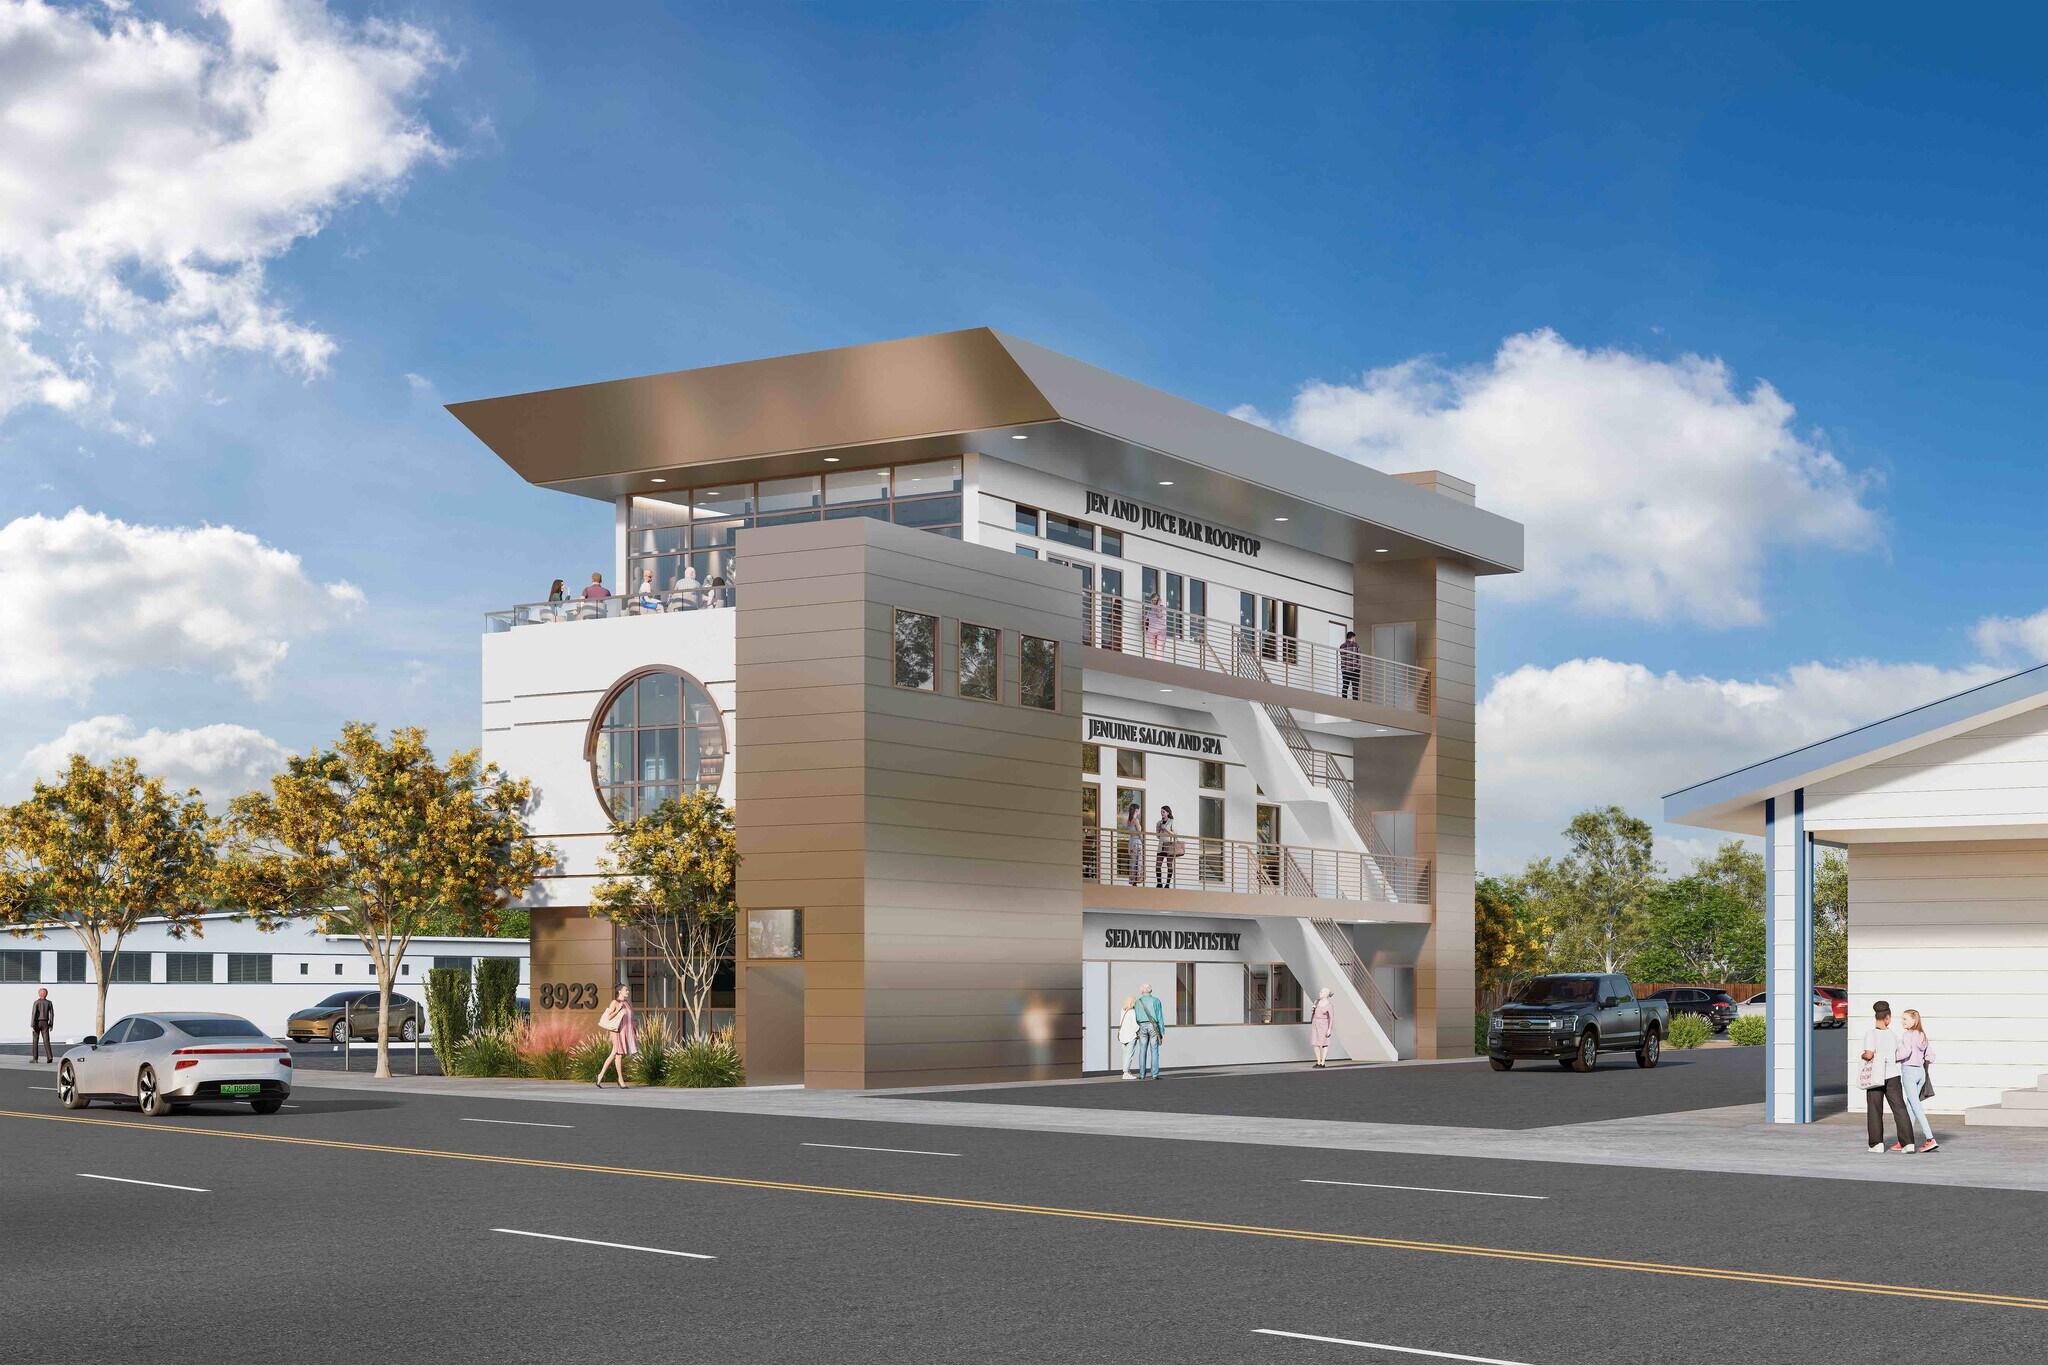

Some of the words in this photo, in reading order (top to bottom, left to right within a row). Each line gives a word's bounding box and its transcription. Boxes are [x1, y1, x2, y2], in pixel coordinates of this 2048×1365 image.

[1085, 490, 1109, 515] JEN
[1110, 499, 1140, 523] AND
[1141, 507, 1176, 534] JUICE
[1178, 518, 1203, 542] BAR
[1204, 525, 1261, 557] ROOFTOP
[1088, 718, 1137, 742] JENUINE
[1138, 727, 1176, 748] SALON
[1177, 733, 1201, 751] AND
[1202, 737, 1222, 755] SPA
[1105, 928, 1172, 949] SEDATION
[1174, 931, 1241, 951] DENTISTRY
[540, 982, 598, 1009] 8923
